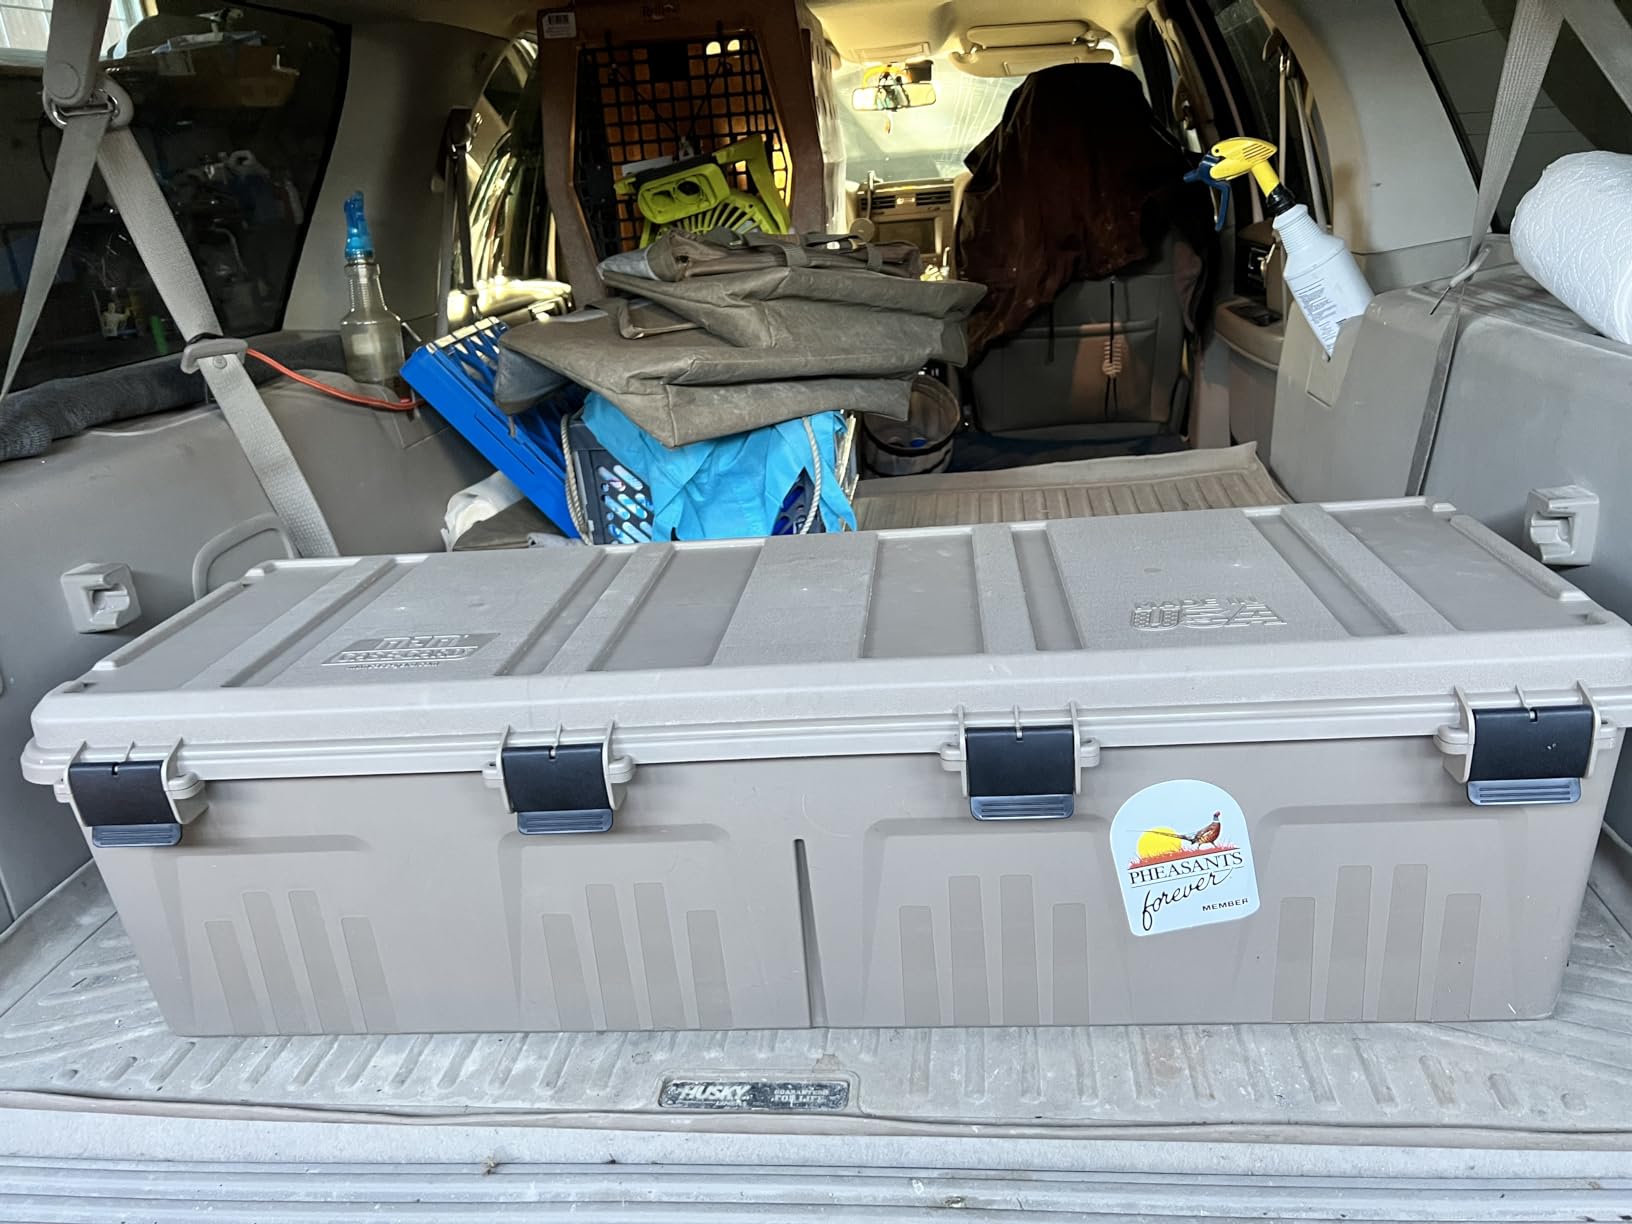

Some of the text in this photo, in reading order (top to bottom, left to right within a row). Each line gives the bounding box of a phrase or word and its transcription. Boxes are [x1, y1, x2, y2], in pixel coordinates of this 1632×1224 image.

[1129, 851, 1243, 885] PHEASANTS
[1142, 867, 1234, 931] forever
[1202, 898, 1249, 912] MEMBER
[678, 1085, 751, 1100] HUSKY
